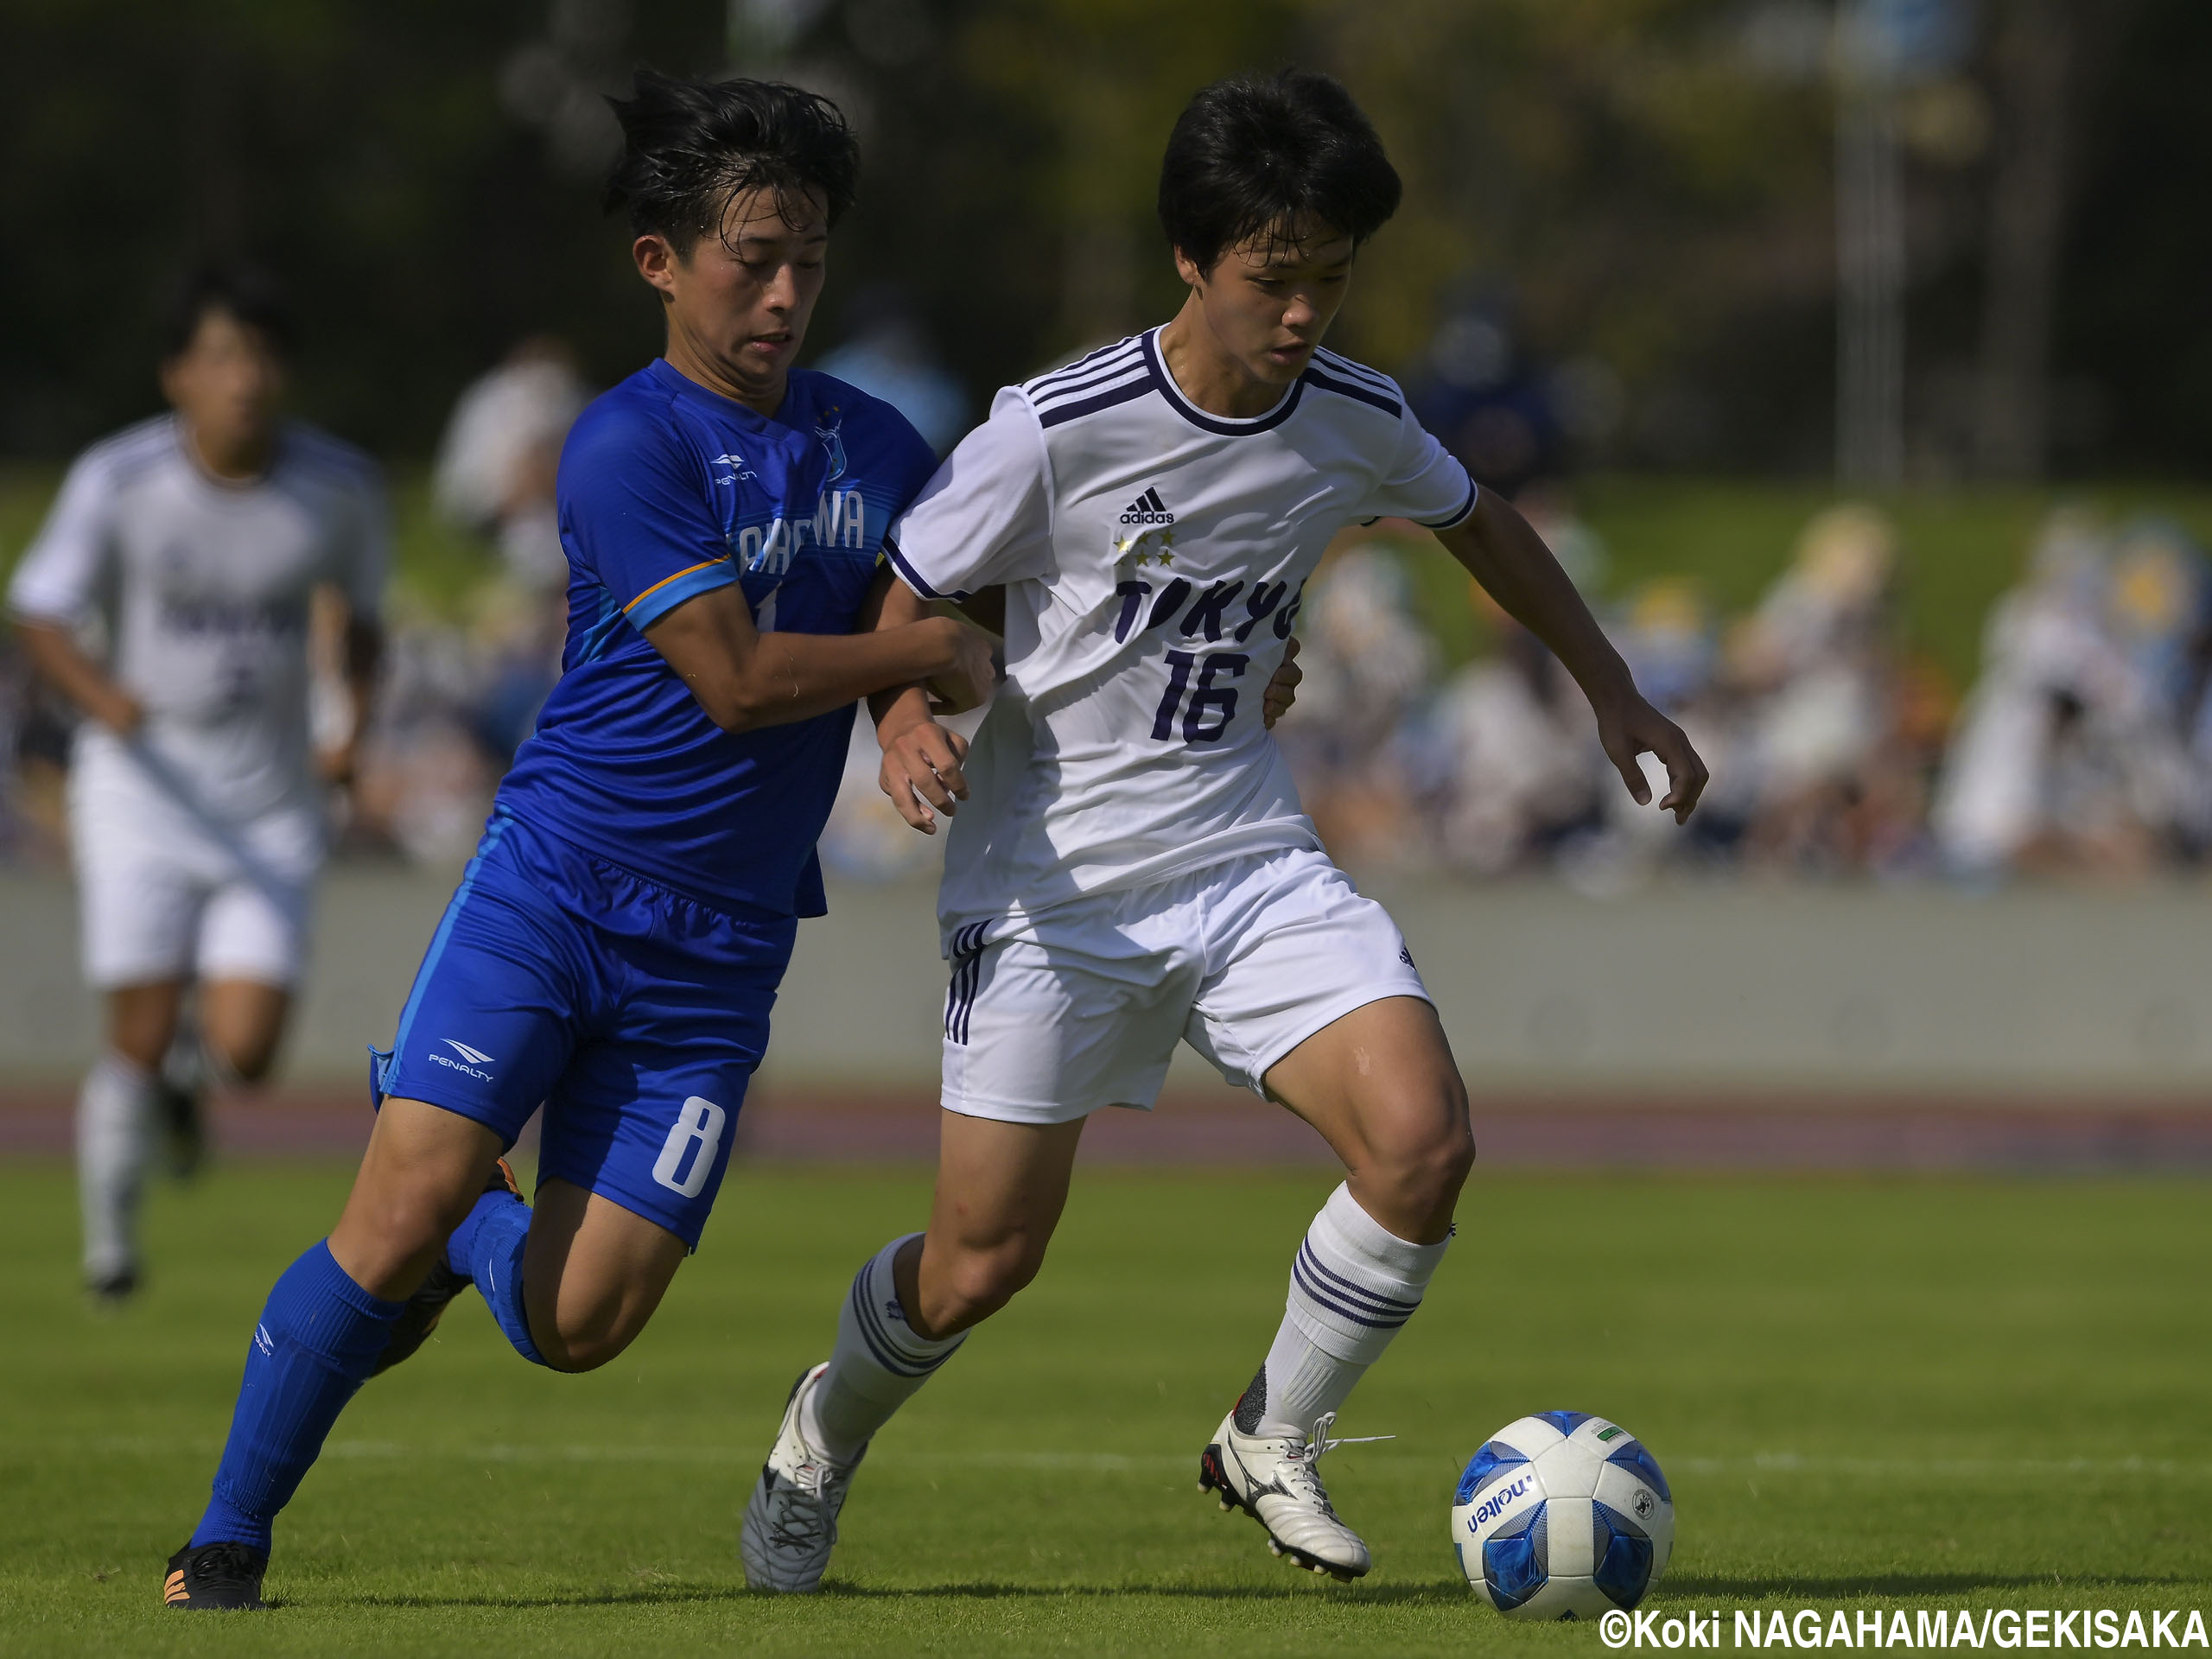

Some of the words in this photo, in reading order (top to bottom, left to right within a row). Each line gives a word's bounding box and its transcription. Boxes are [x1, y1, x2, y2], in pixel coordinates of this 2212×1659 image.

[1120, 511, 1174, 524] adidas
[1150, 649, 1250, 743] 16
[429, 1053, 493, 1083] PENALTY
[652, 1096, 727, 1198] 8
[1467, 1475, 1533, 1533] molten
